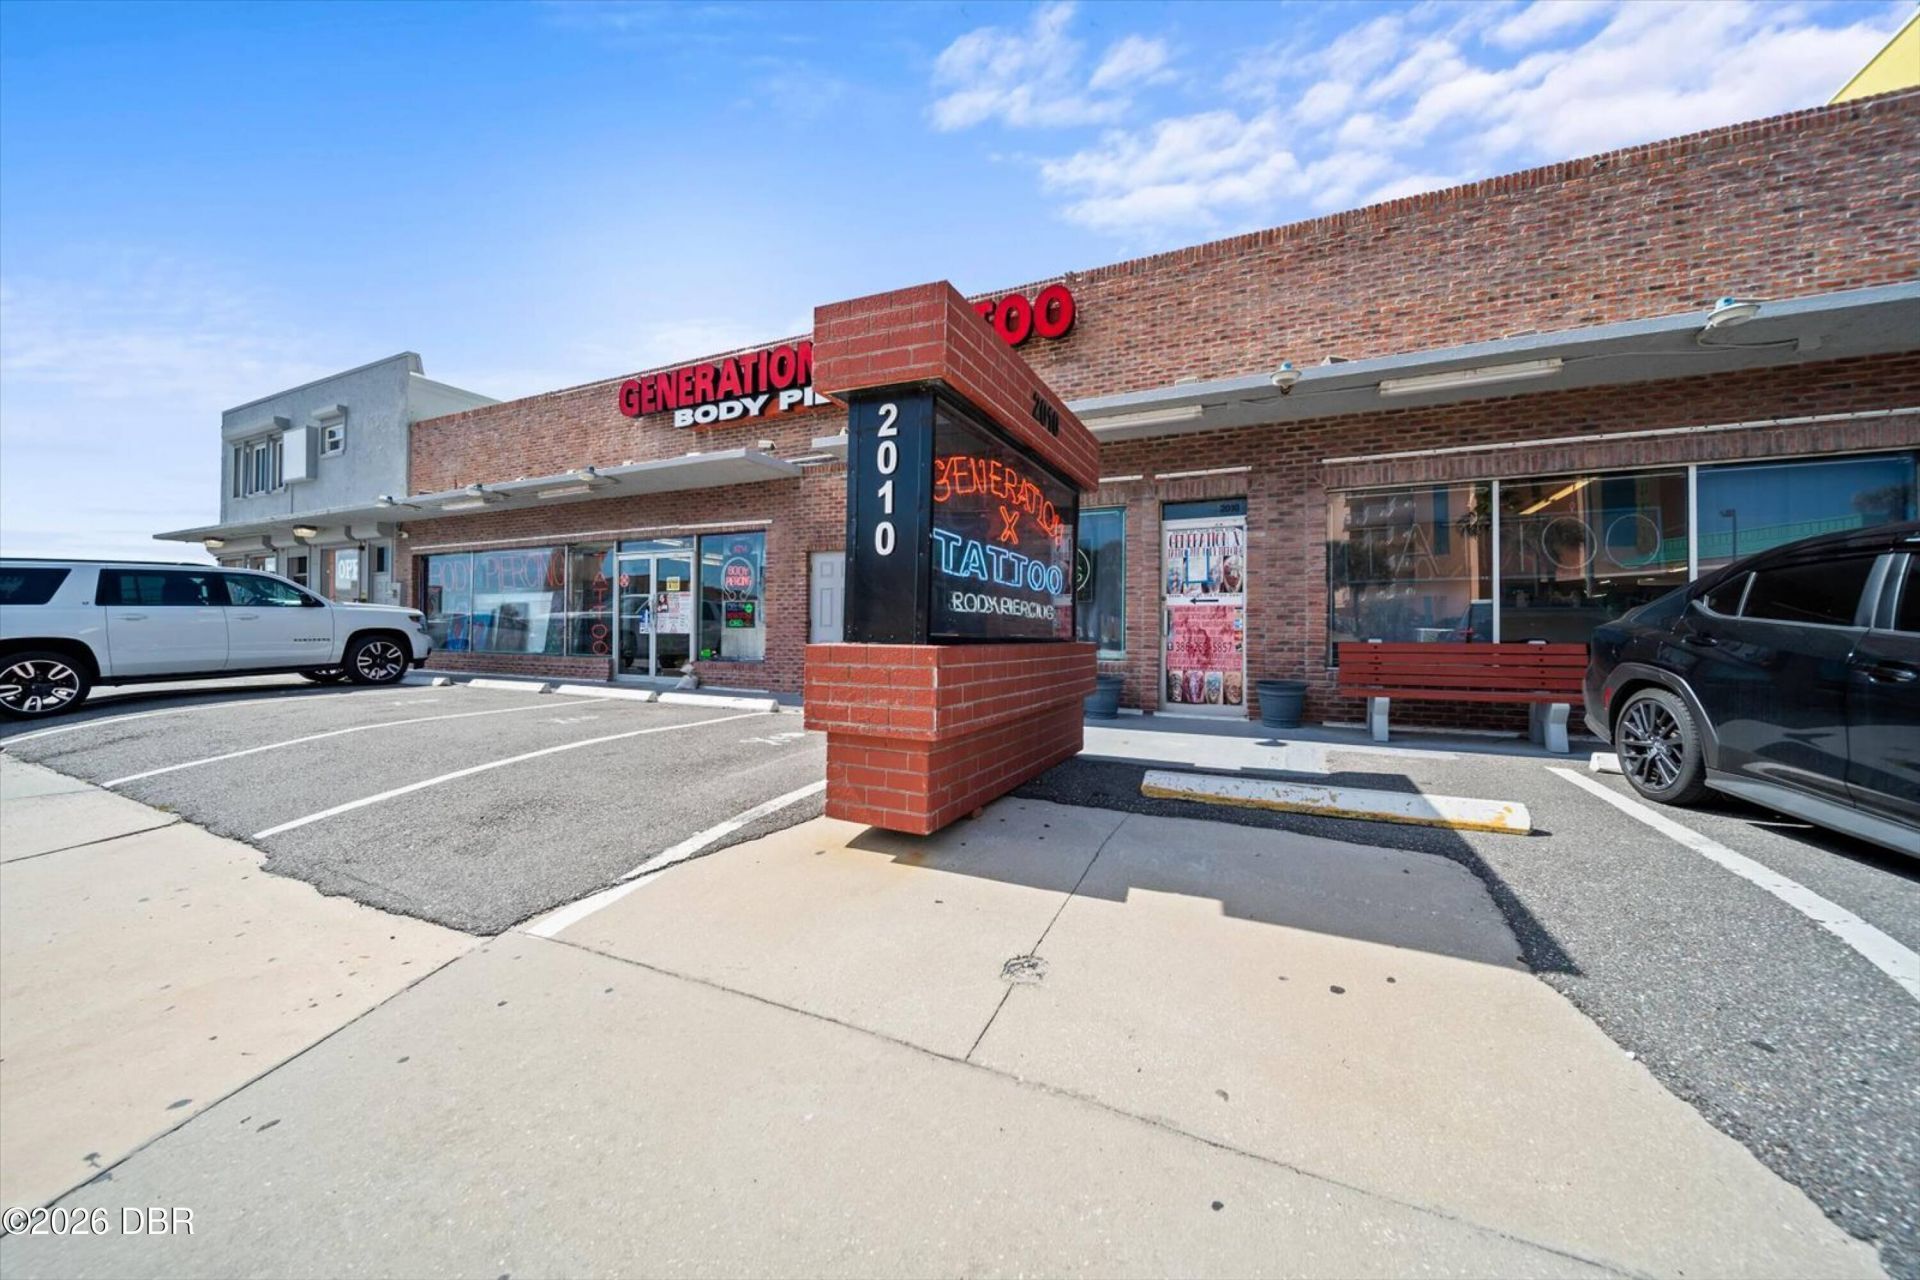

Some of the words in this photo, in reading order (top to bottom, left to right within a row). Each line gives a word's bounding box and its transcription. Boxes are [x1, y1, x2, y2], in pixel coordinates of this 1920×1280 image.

[674, 394, 770, 429] BODY
[874, 403, 899, 556] 2010
[1000, 505, 1020, 544] X
[485, 551, 565, 590] PIERCING
[933, 527, 1063, 595] TATTOO
[591, 551, 609, 655] TATTOO
[951, 591, 1000, 614] BODY
[1000, 596, 1056, 620] PIERCING
